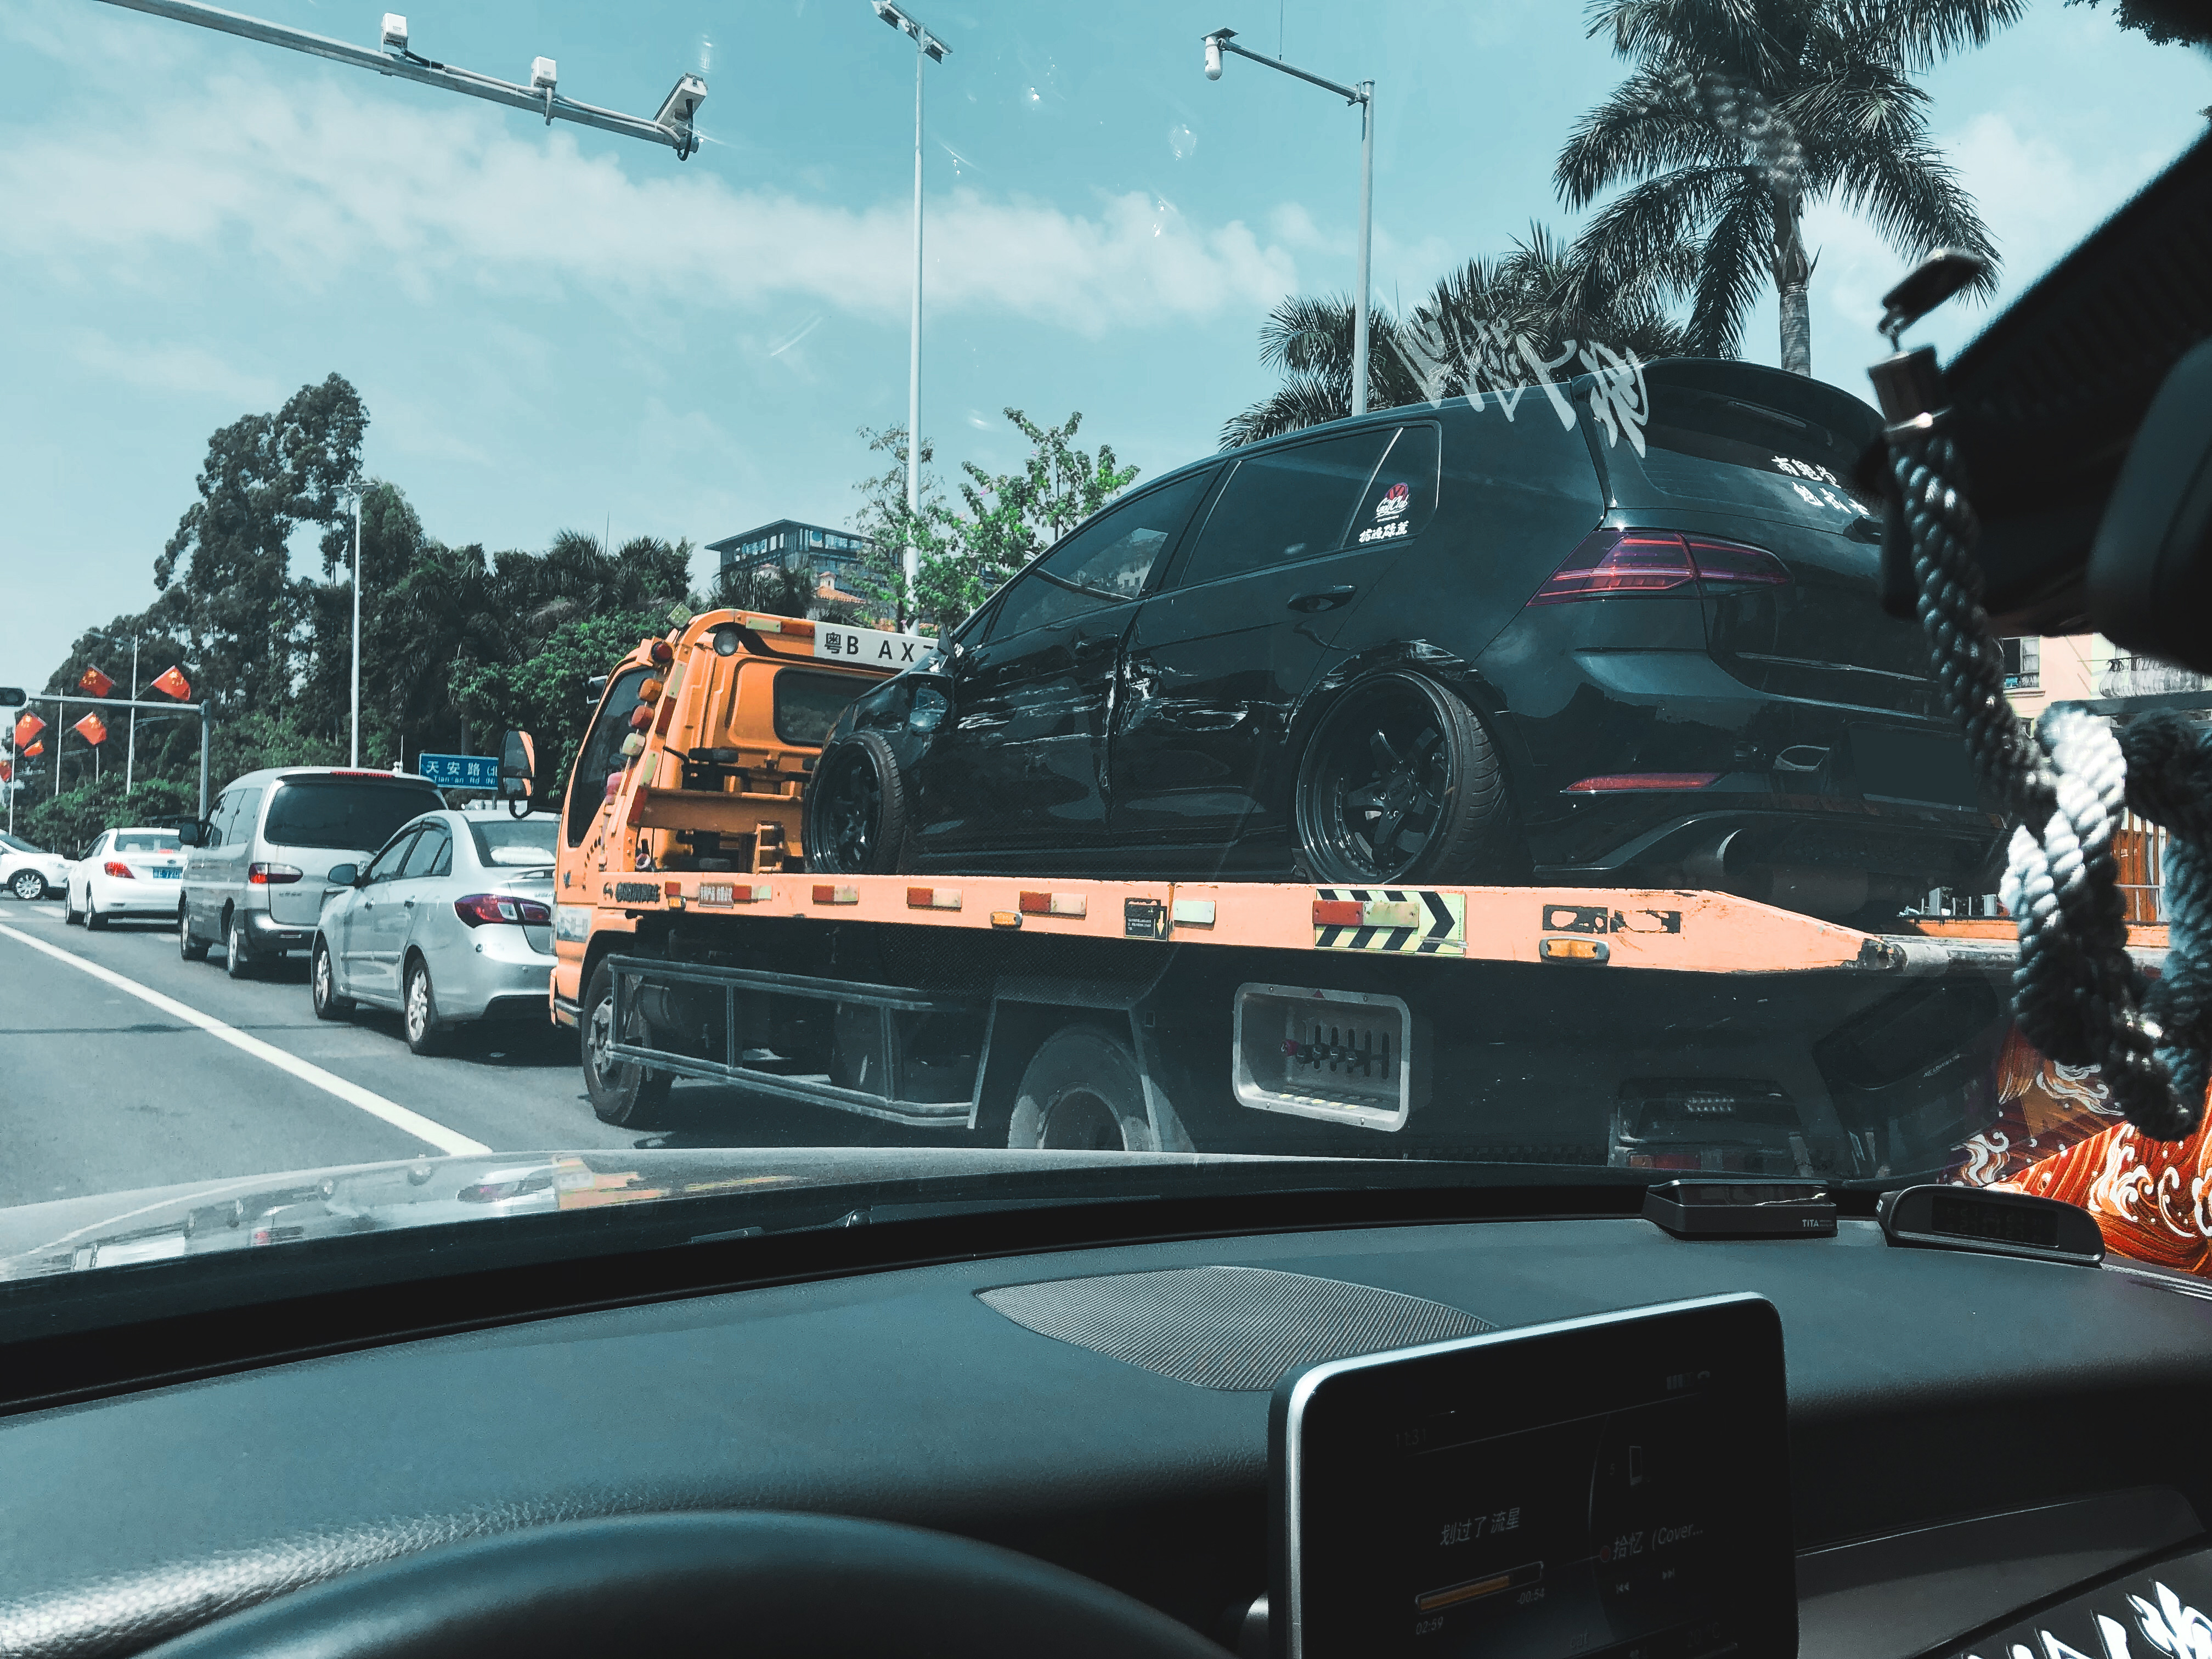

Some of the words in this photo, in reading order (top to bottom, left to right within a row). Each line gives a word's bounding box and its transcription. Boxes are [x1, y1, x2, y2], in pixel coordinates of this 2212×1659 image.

[825, 632, 859, 655] 粤B
[1802, 1219, 1819, 1227] TITA
[1440, 1514, 1487, 1547] 划过了
[1490, 1506, 1520, 1535] 流星
[1613, 1530, 1643, 1561] 拾忆
[1415, 1616, 1444, 1635] 02:59
